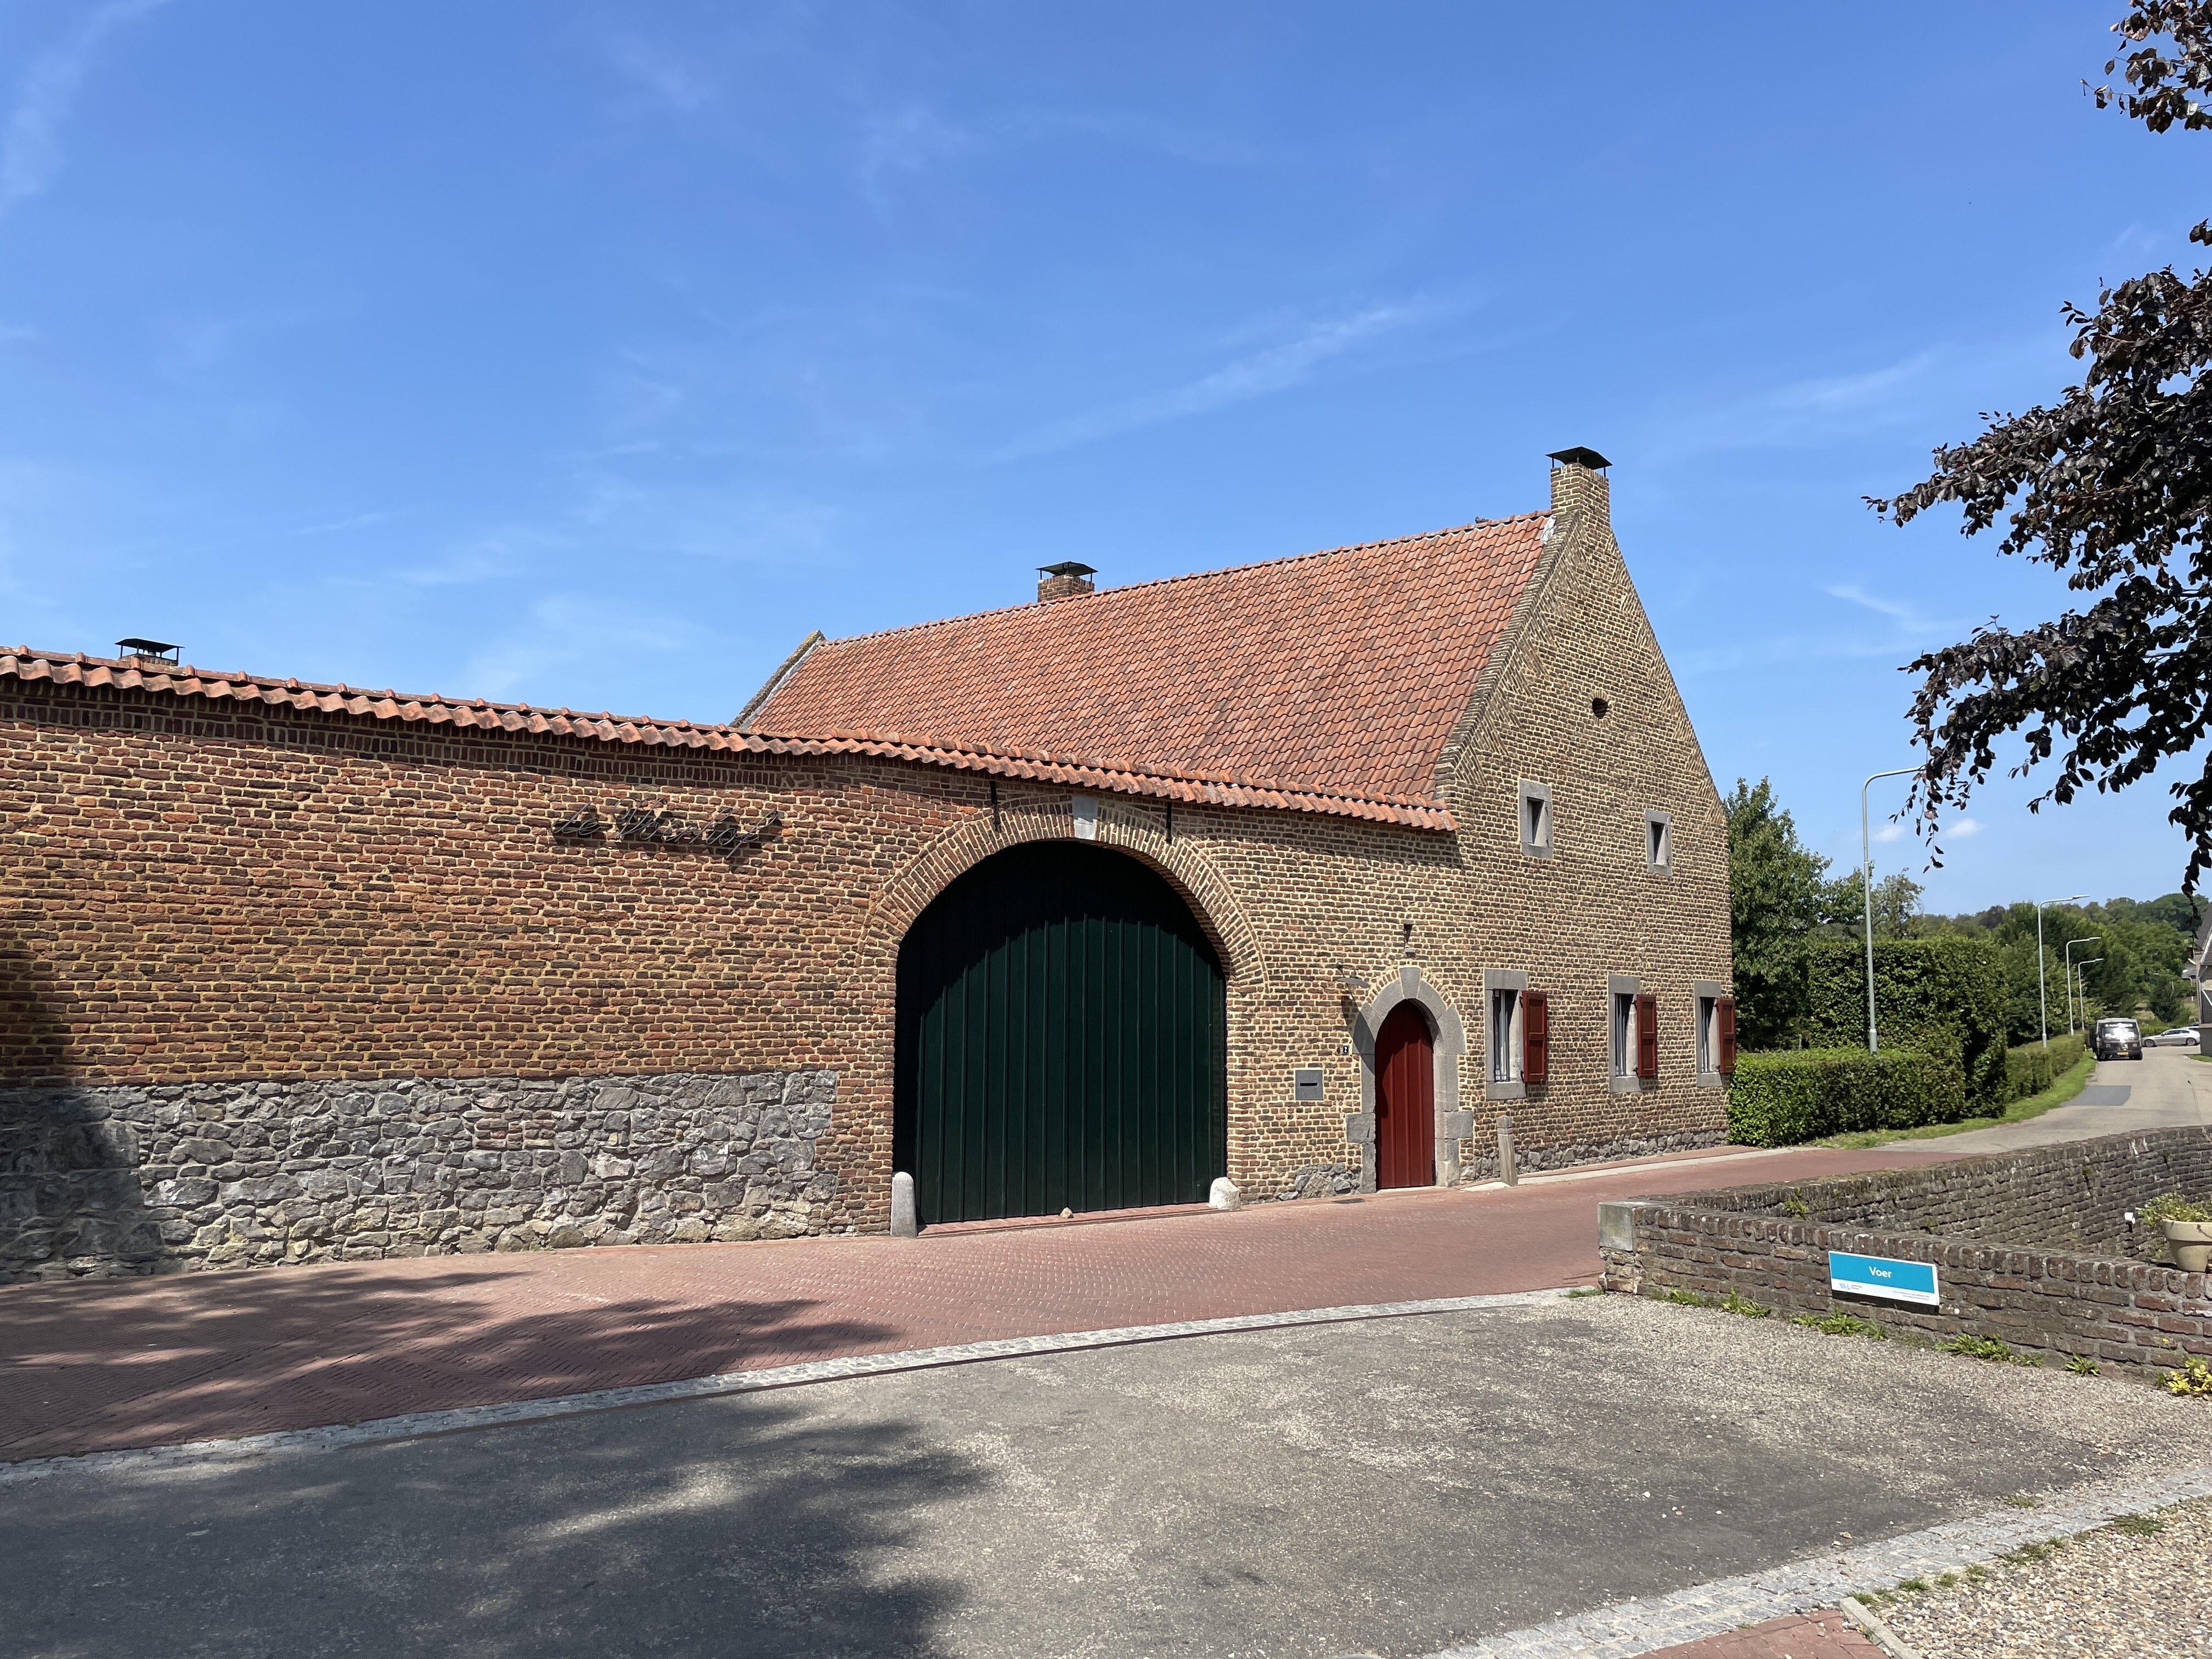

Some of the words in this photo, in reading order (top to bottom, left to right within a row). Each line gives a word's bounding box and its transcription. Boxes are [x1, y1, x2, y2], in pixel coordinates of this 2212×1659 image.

[551, 800, 602, 836] de
[613, 797, 779, 859] Voerhof
[1869, 1266, 1892, 1278] Voer
